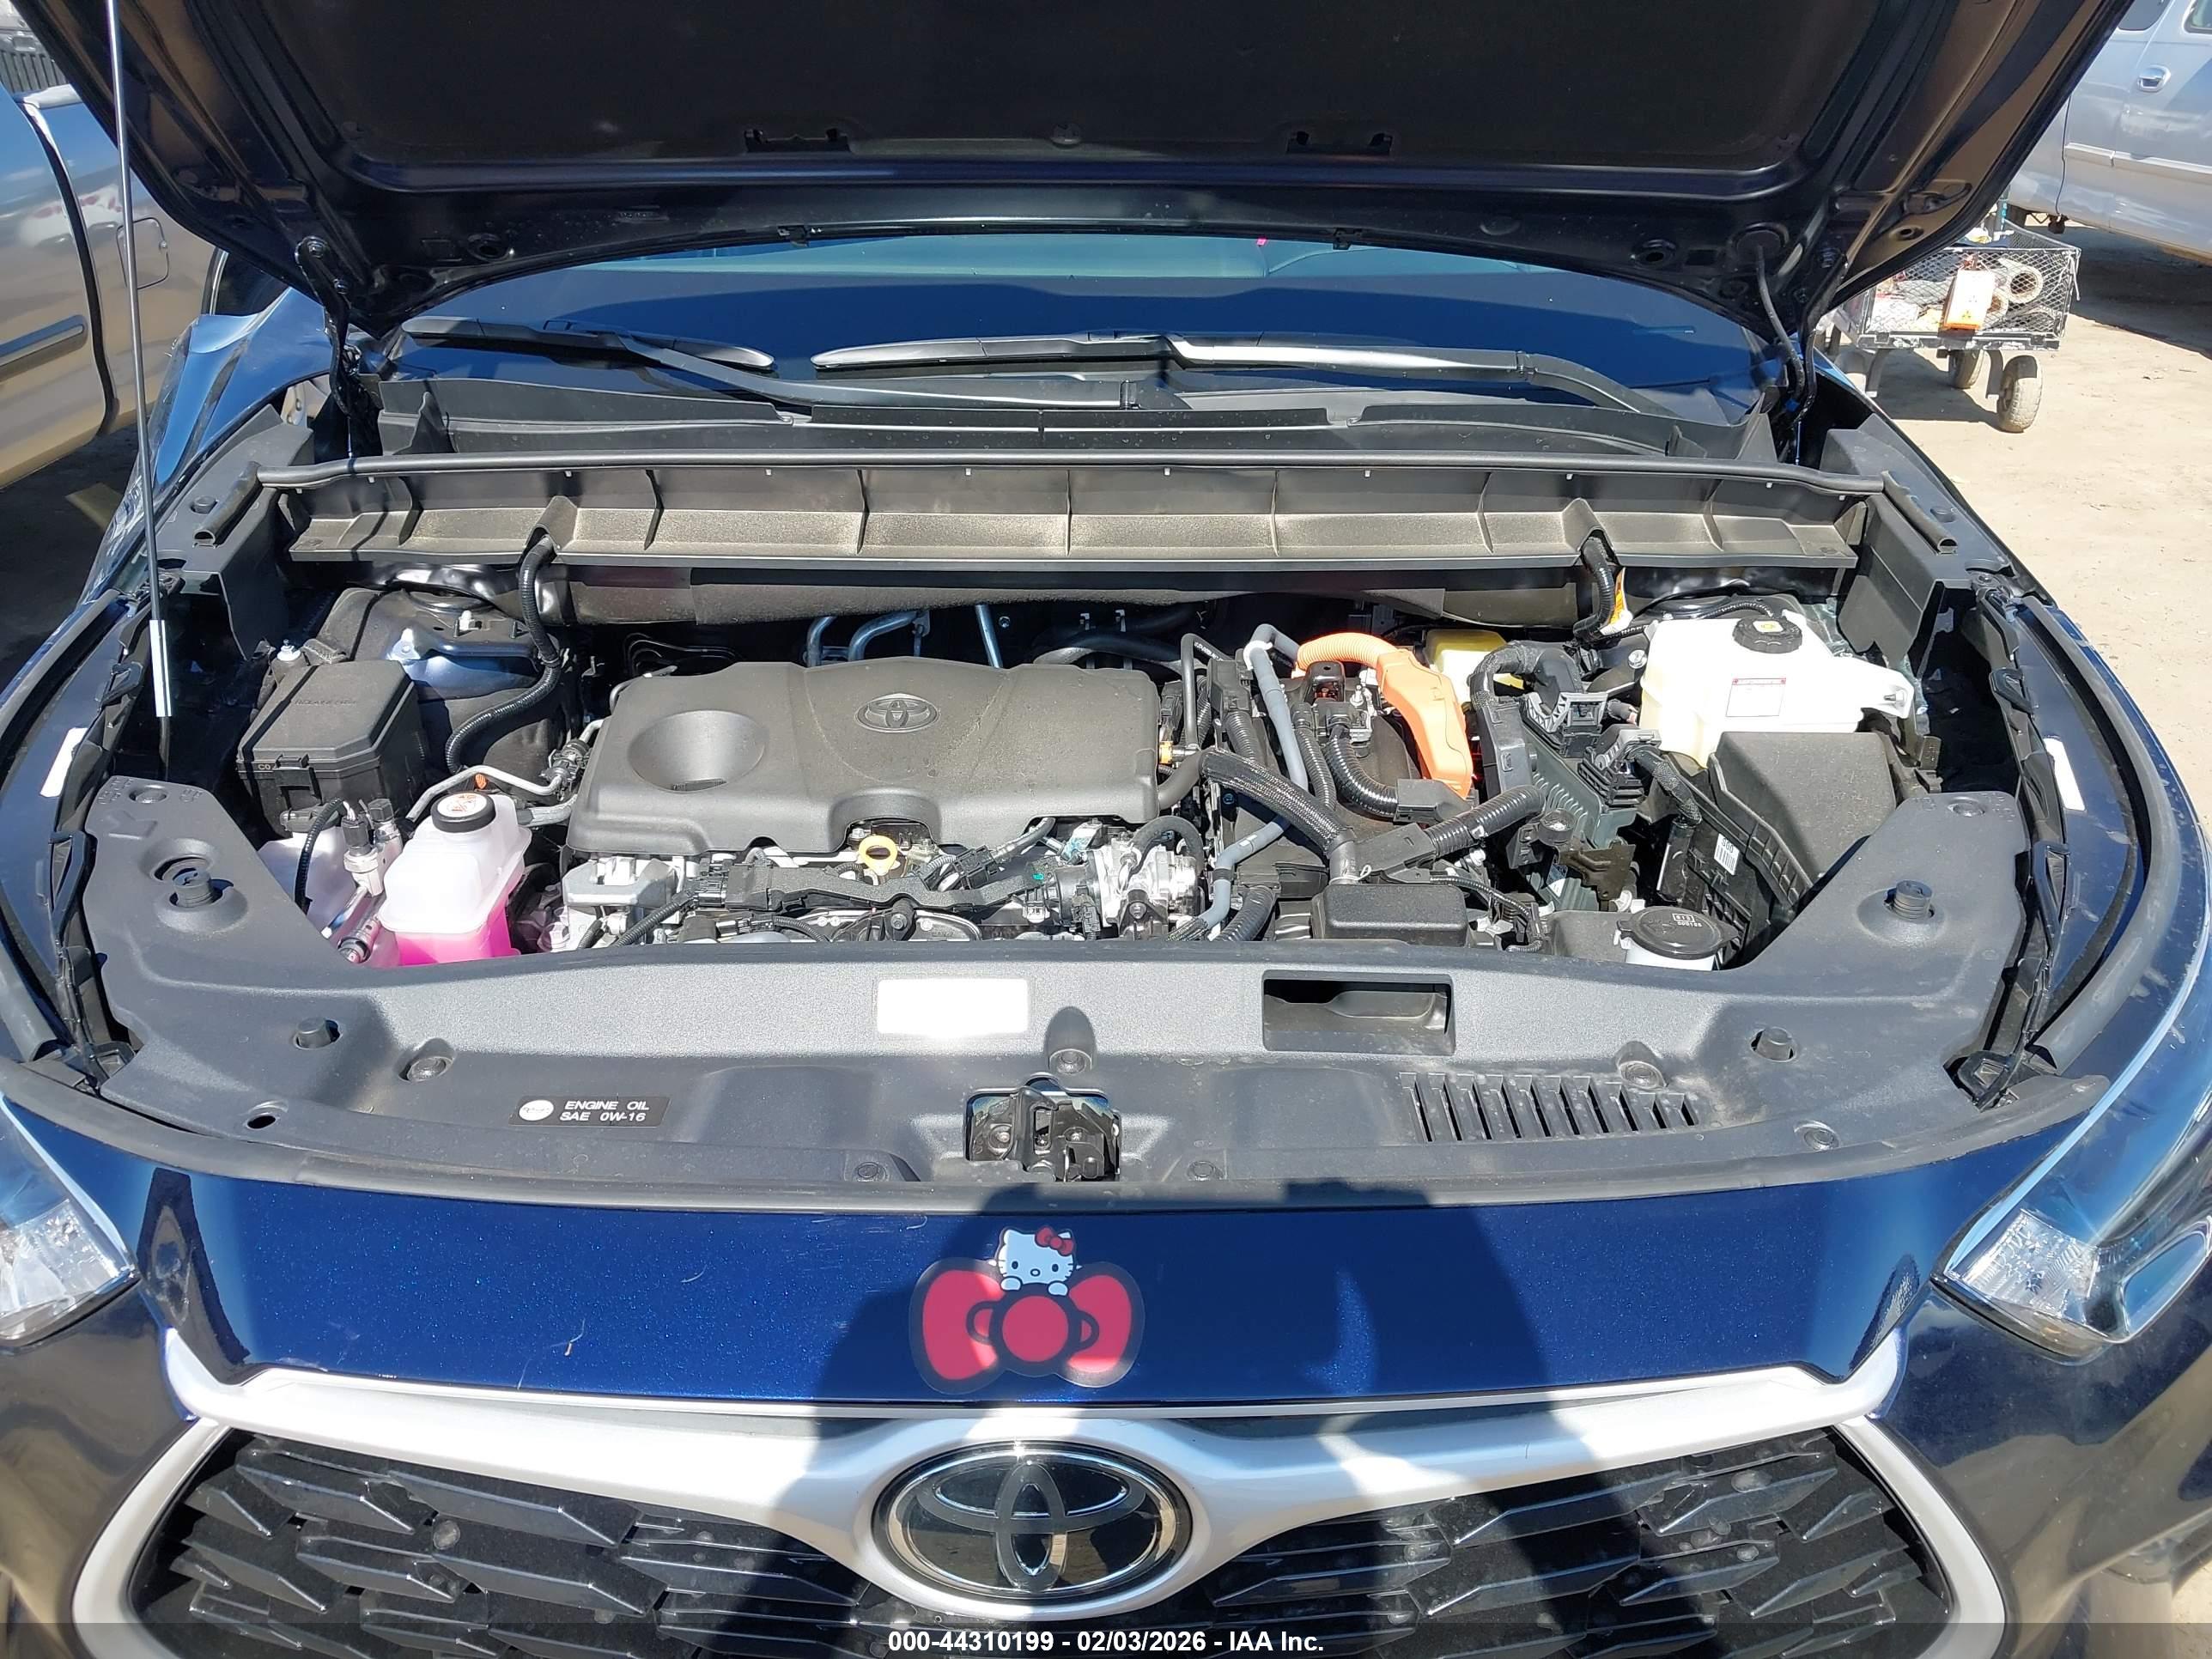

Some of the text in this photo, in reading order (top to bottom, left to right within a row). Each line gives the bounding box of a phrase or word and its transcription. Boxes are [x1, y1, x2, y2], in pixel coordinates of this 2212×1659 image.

[564, 1101, 650, 1110] ENGINE OIL
[559, 1111, 647, 1121] SAE 0W-16
